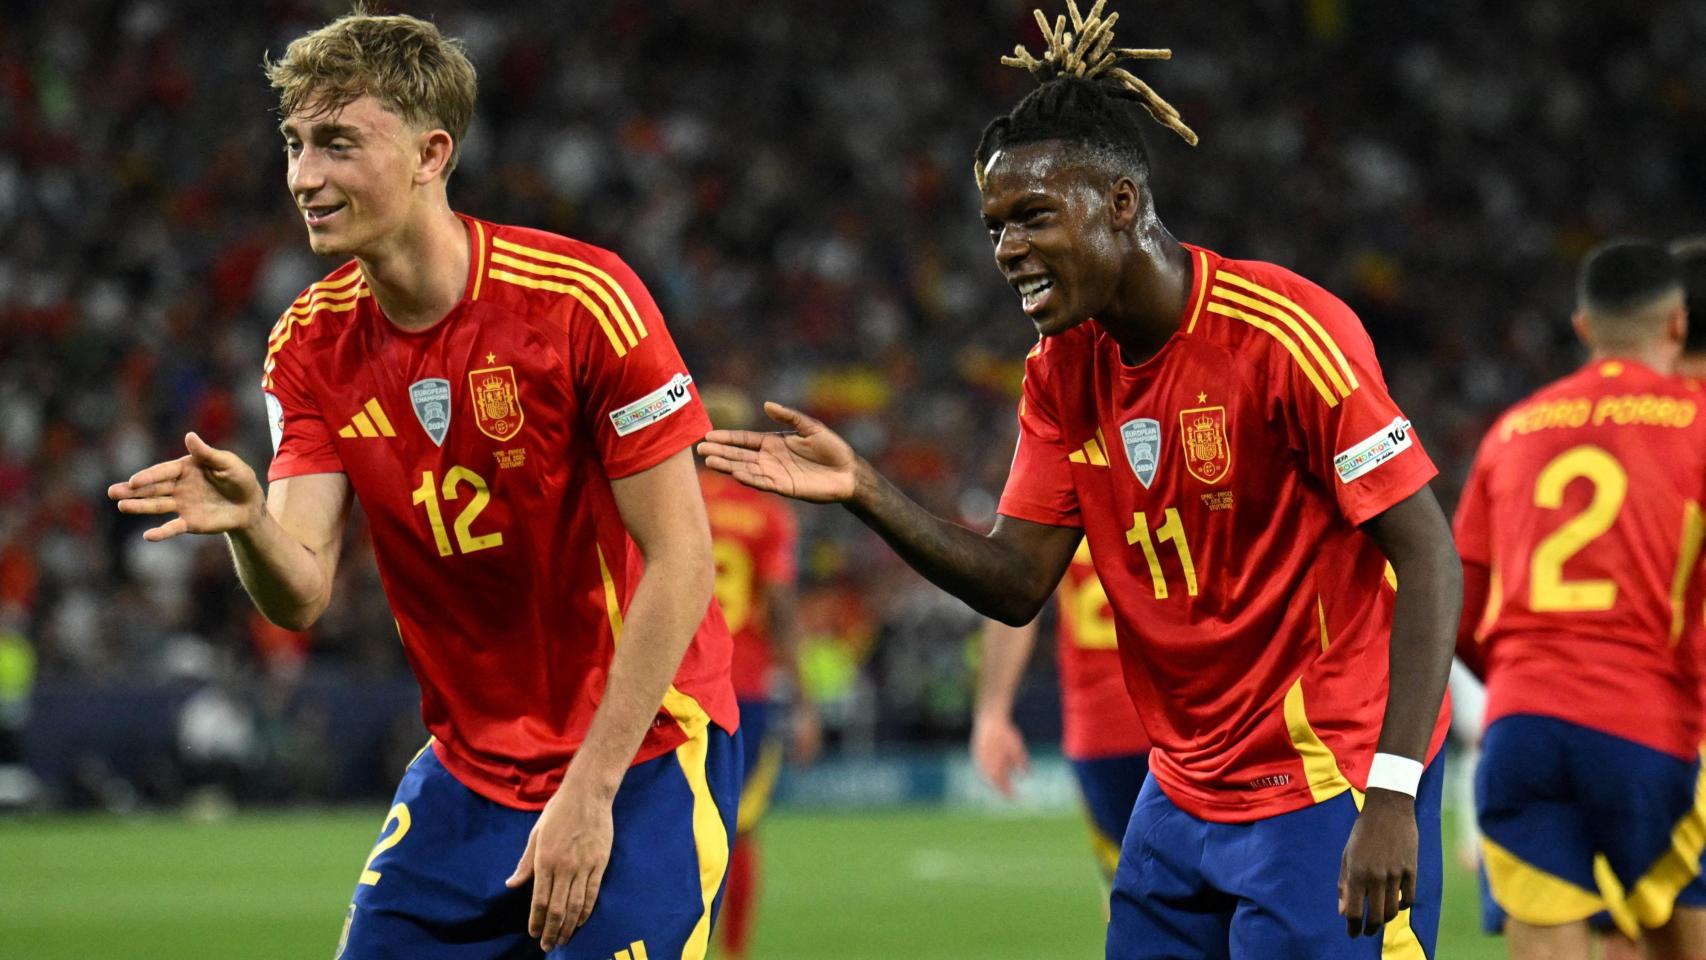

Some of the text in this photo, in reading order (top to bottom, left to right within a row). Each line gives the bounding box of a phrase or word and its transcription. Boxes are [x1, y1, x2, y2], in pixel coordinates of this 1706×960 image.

[1500, 394, 1697, 443] PEDRO PORRO
[412, 465, 503, 557] 12
[1125, 507, 1198, 599] 11
[1529, 444, 1628, 612] 2
